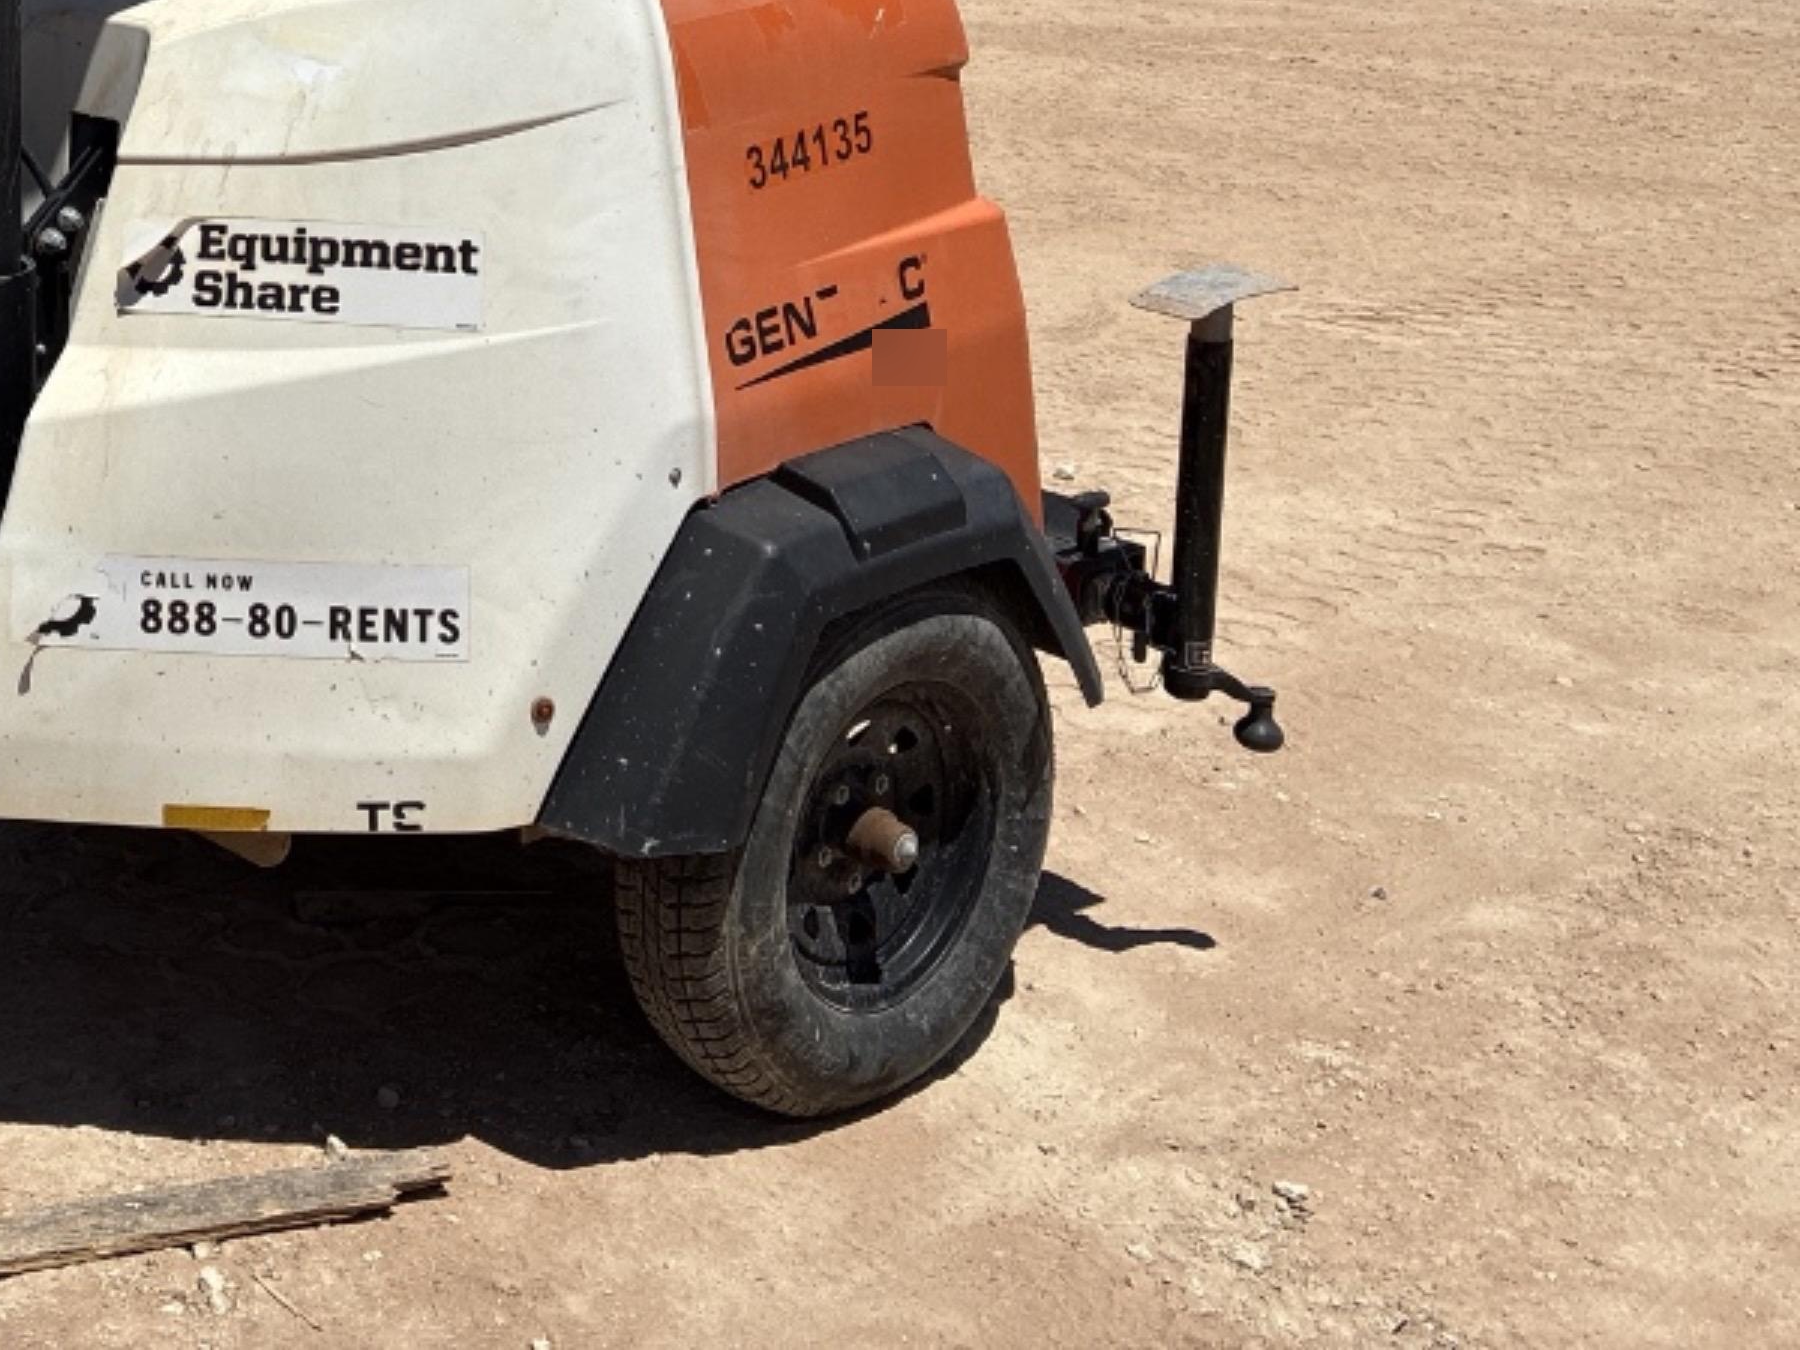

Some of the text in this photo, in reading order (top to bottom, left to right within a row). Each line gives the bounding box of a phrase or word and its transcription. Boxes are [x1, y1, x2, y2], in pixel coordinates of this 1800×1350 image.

[746, 111, 872, 189] 344135
[197, 223, 480, 275] Equipment
[192, 270, 341, 314] Share
[724, 253, 929, 366] GENC
[140, 569, 253, 592] CALL NOW
[139, 598, 461, 644] 888-80-RENTS
